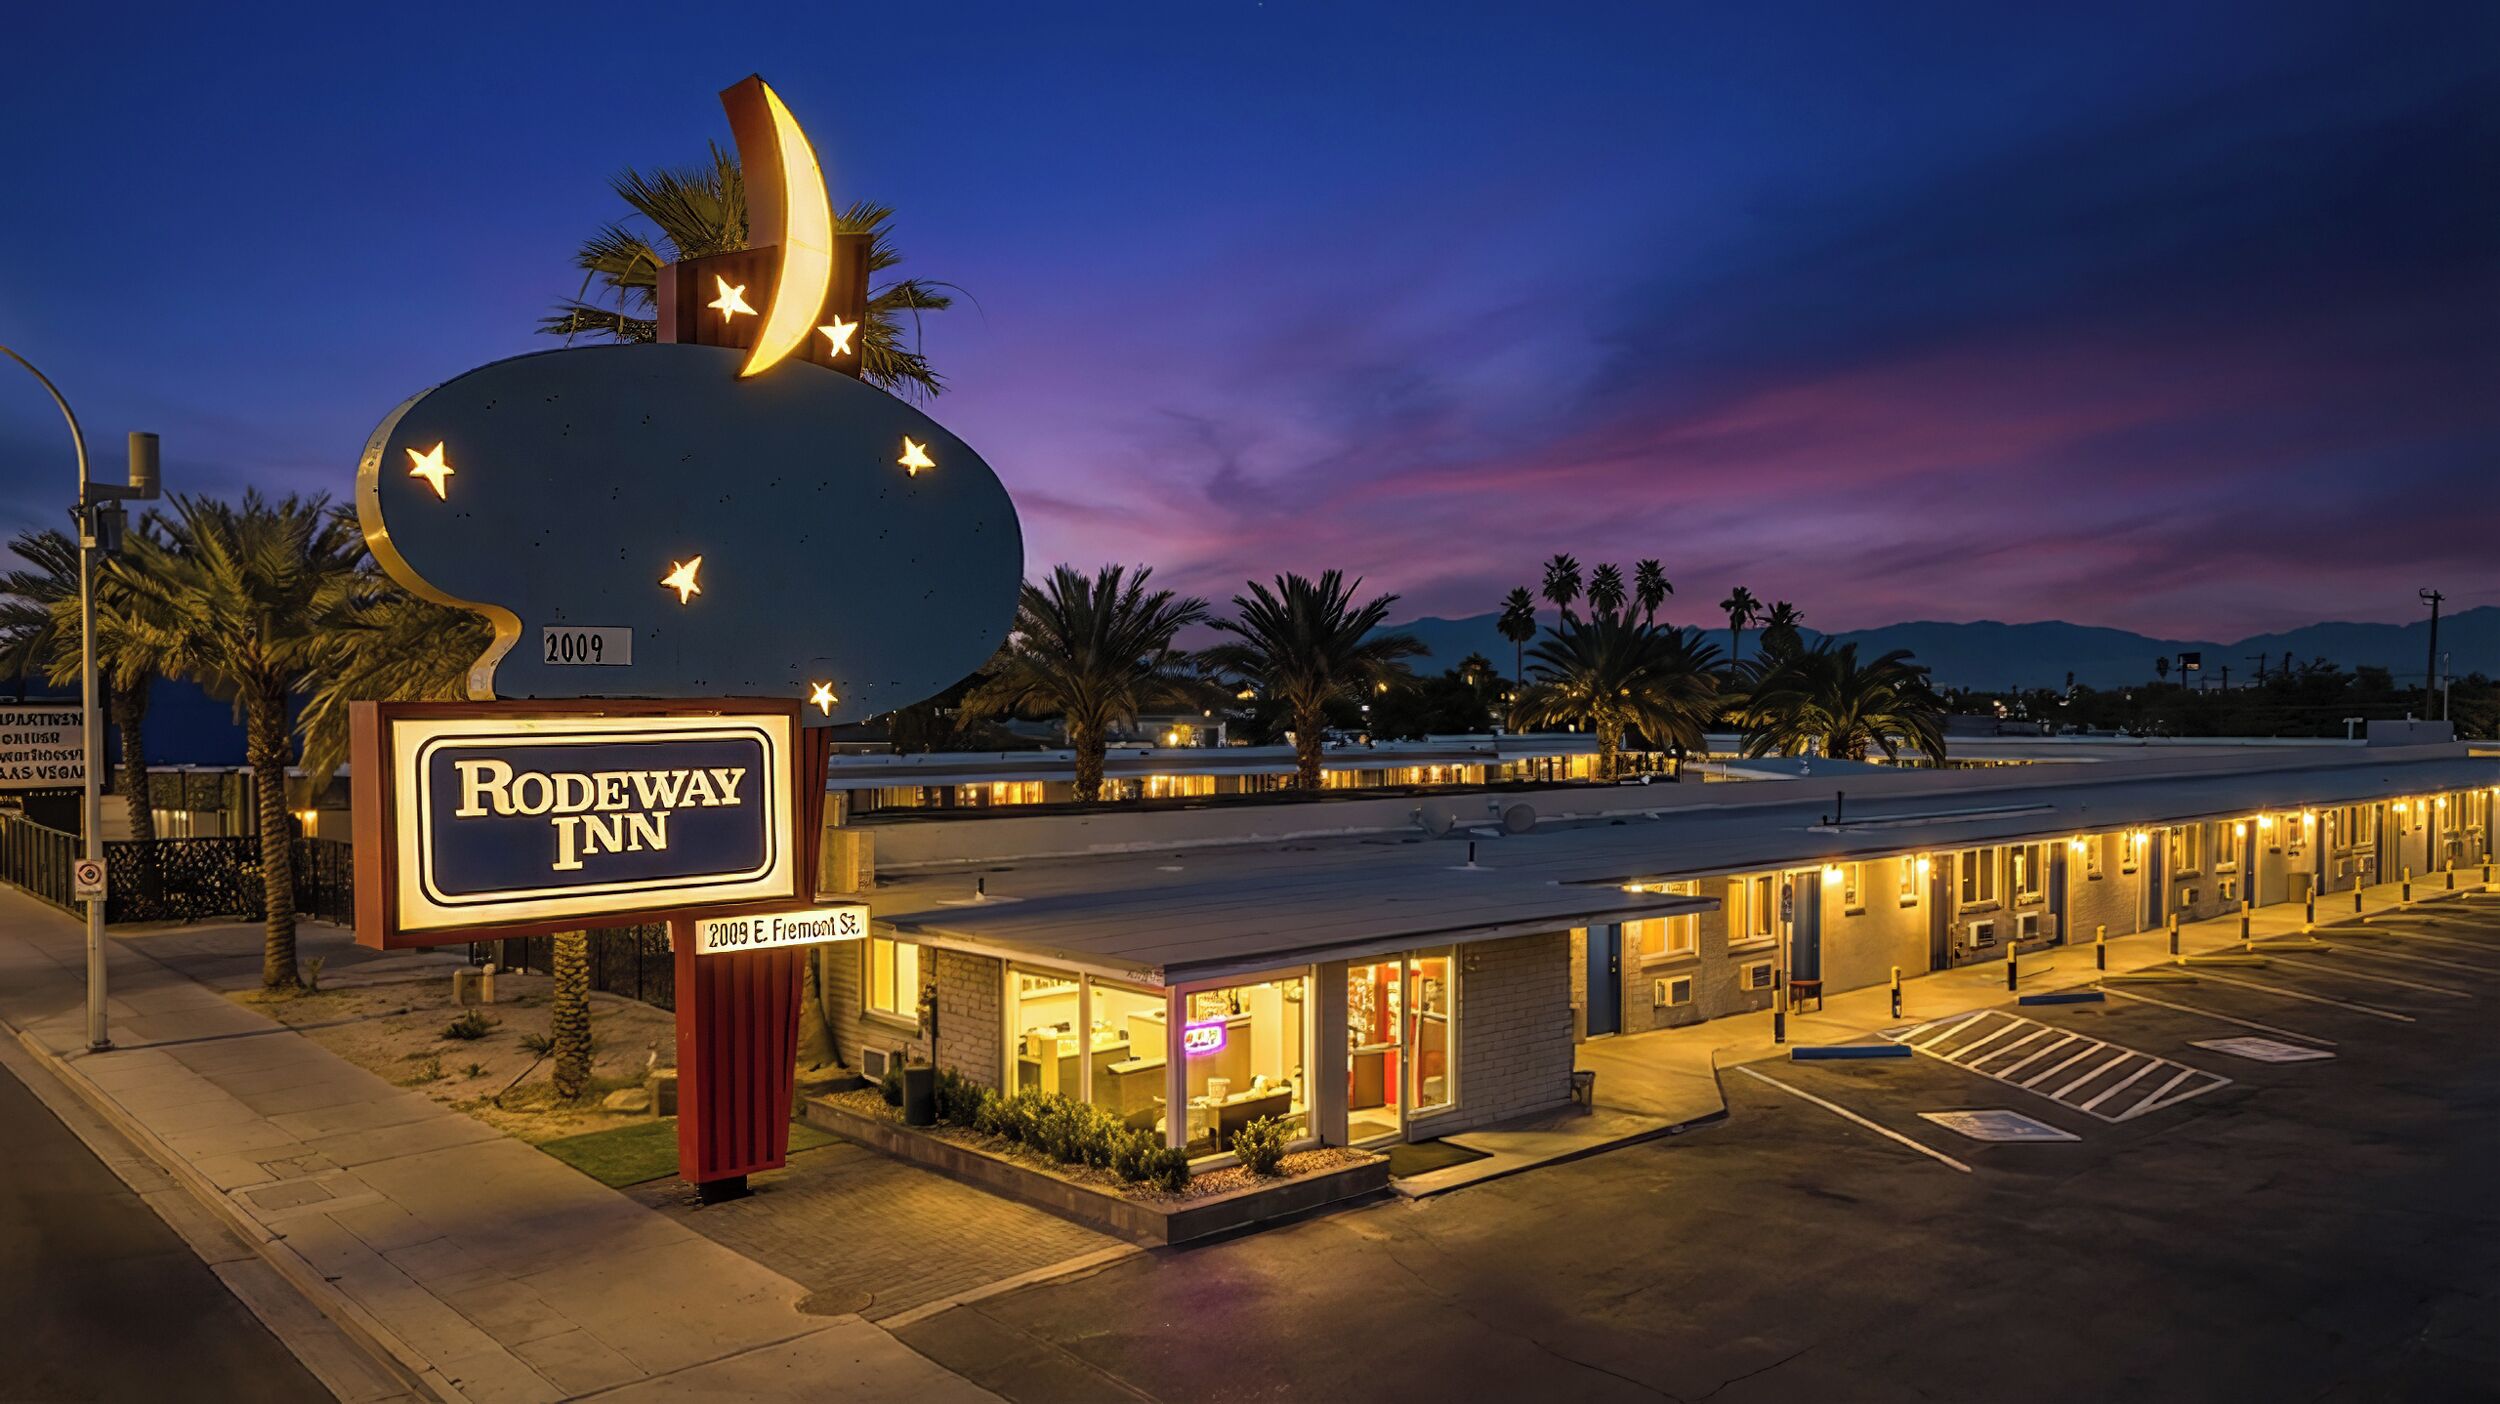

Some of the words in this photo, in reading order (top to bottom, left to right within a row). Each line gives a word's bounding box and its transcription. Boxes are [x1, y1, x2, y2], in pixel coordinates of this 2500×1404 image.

[545, 632, 604, 663] 2009
[454, 759, 746, 818] RODEWAY
[551, 810, 671, 871] INN
[709, 921, 748, 948] 2009
